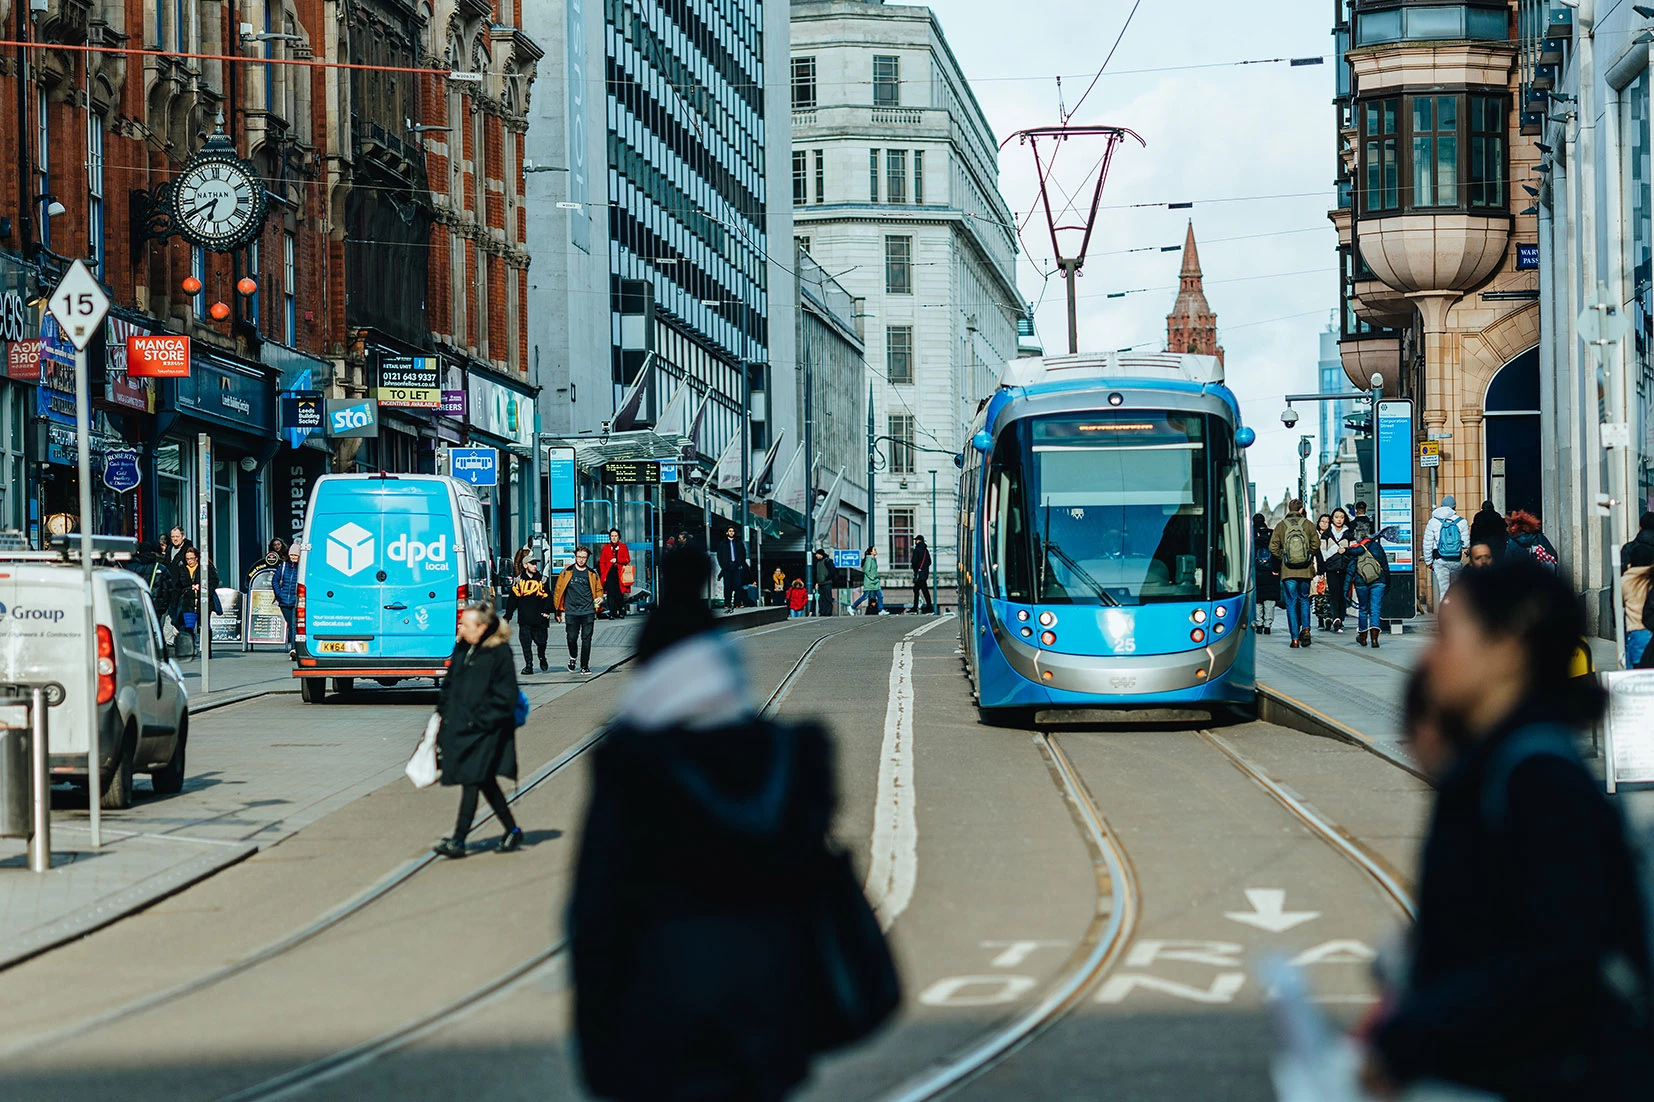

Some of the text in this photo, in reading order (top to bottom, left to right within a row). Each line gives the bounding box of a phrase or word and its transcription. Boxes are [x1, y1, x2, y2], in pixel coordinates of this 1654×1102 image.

[63, 293, 94, 316] 15
[135, 340, 185, 351] MANGA
[144, 351, 185, 361] STORE
[383, 372, 436, 382] 0121 643 9337
[390, 390, 429, 400] TO LET
[334, 409, 367, 428] sta
[107, 453, 136, 461] ROBERTS
[387, 533, 446, 568] dpd
[425, 562, 449, 571] local
[12, 605, 64, 623] Group
[1114, 638, 1136, 653] 25
